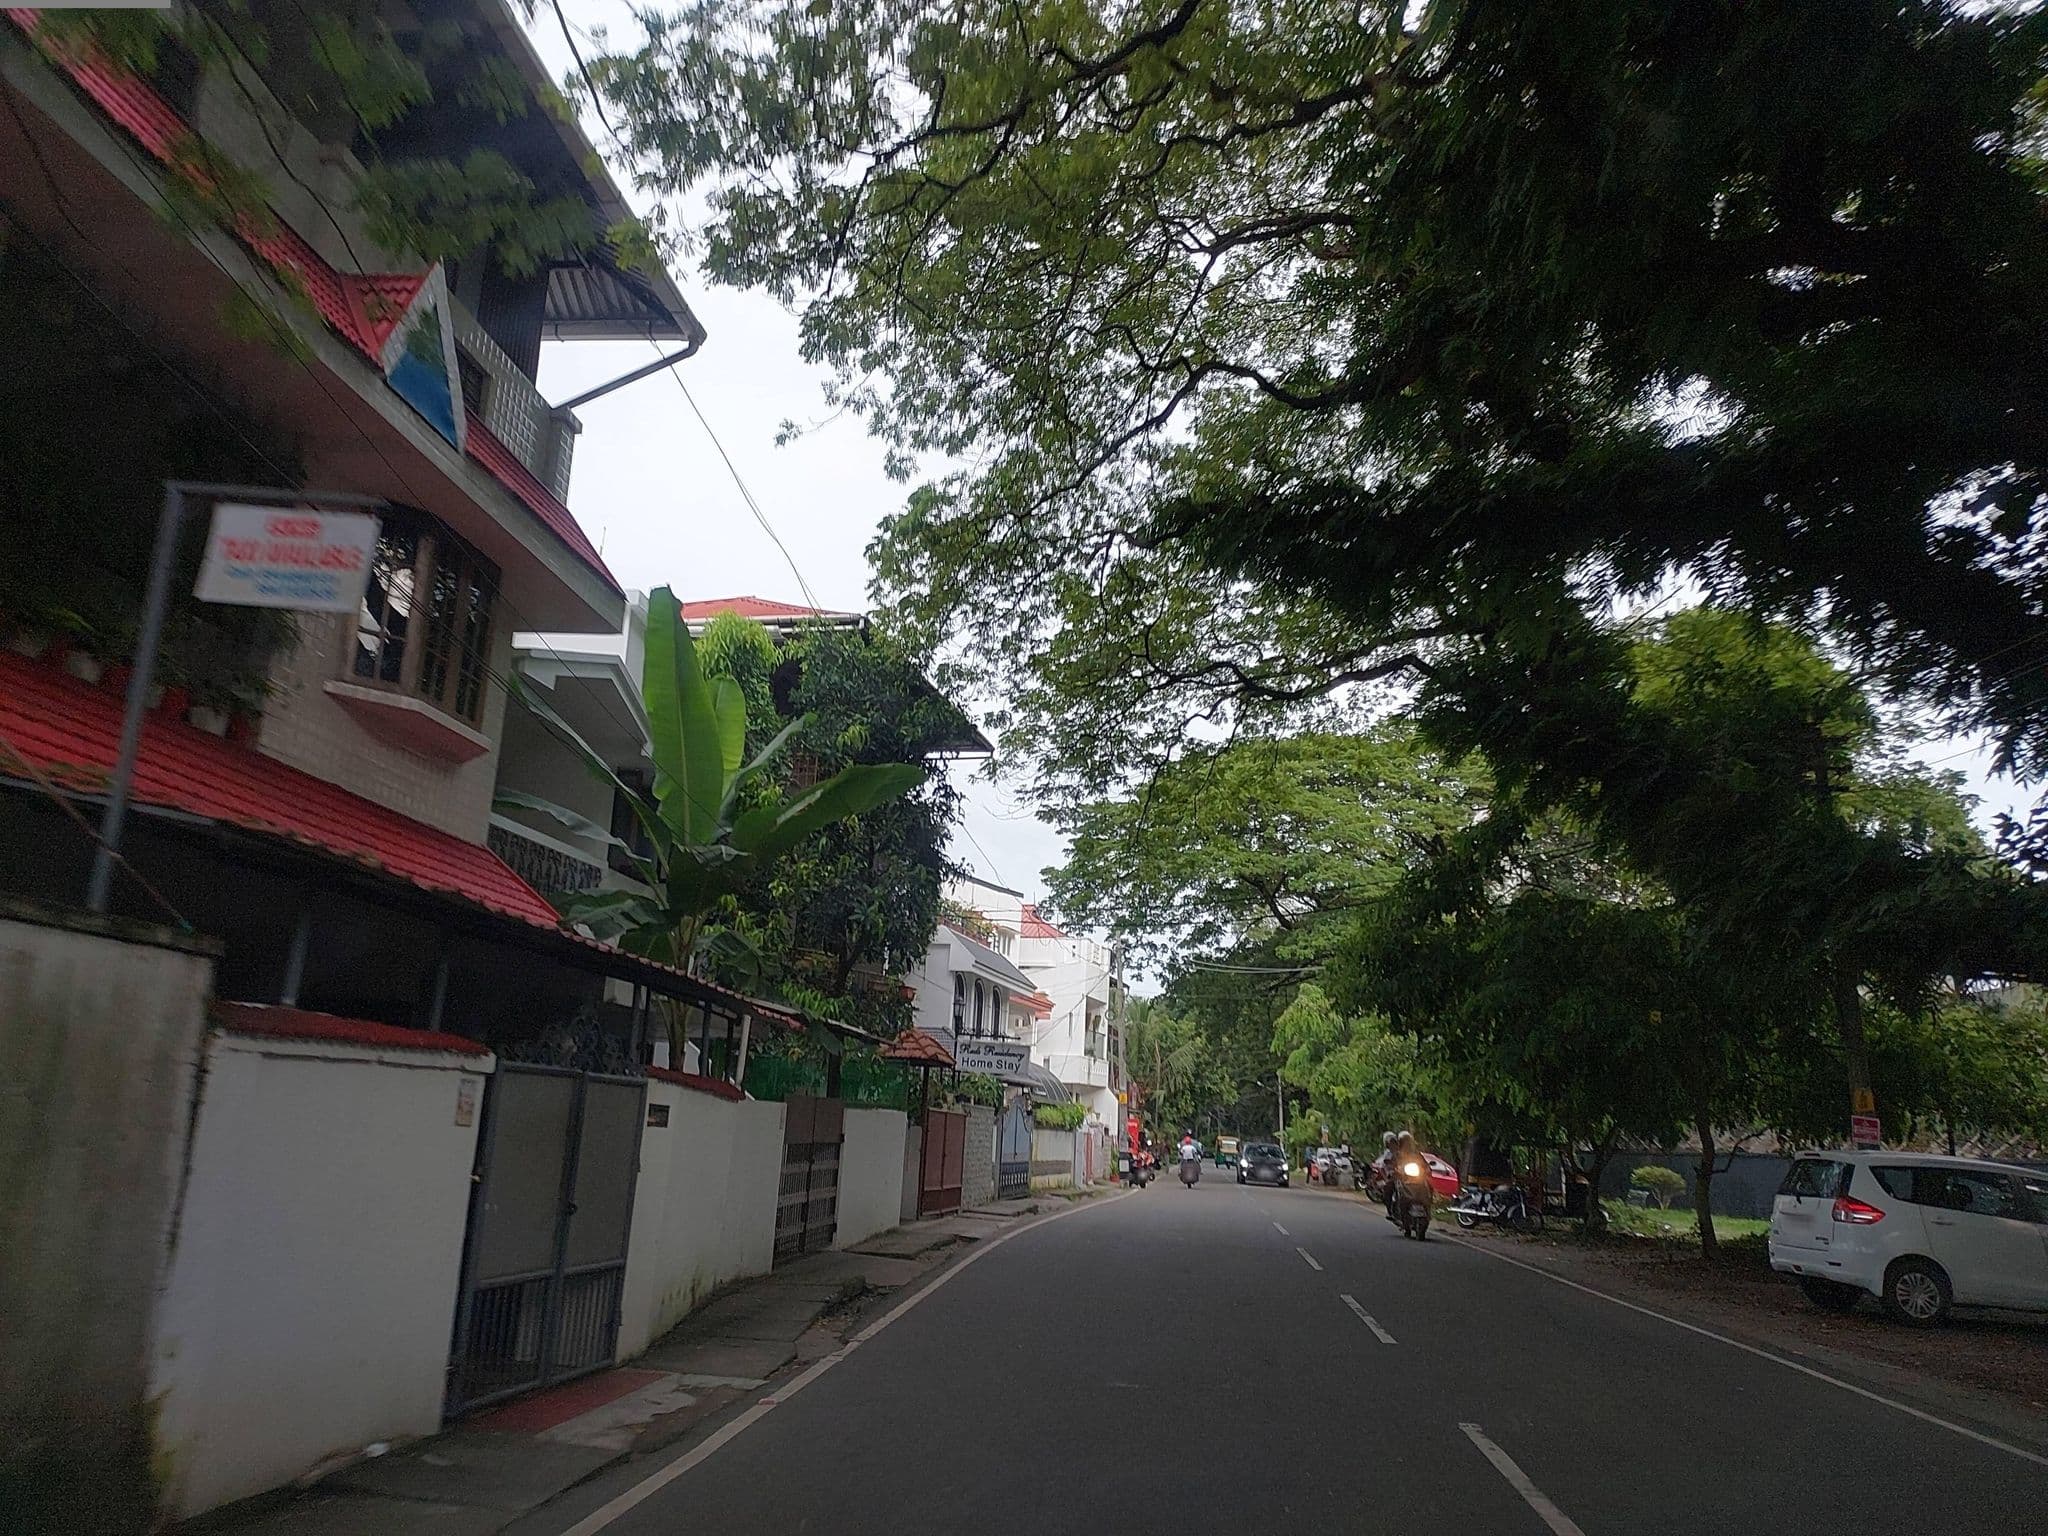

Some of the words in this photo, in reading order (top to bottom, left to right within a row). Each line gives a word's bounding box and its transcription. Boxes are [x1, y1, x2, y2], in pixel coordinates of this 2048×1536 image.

[984, 1045, 1025, 1062] Residency
[961, 1057, 993, 1069] Home
[995, 1059, 1021, 1074] Stay
